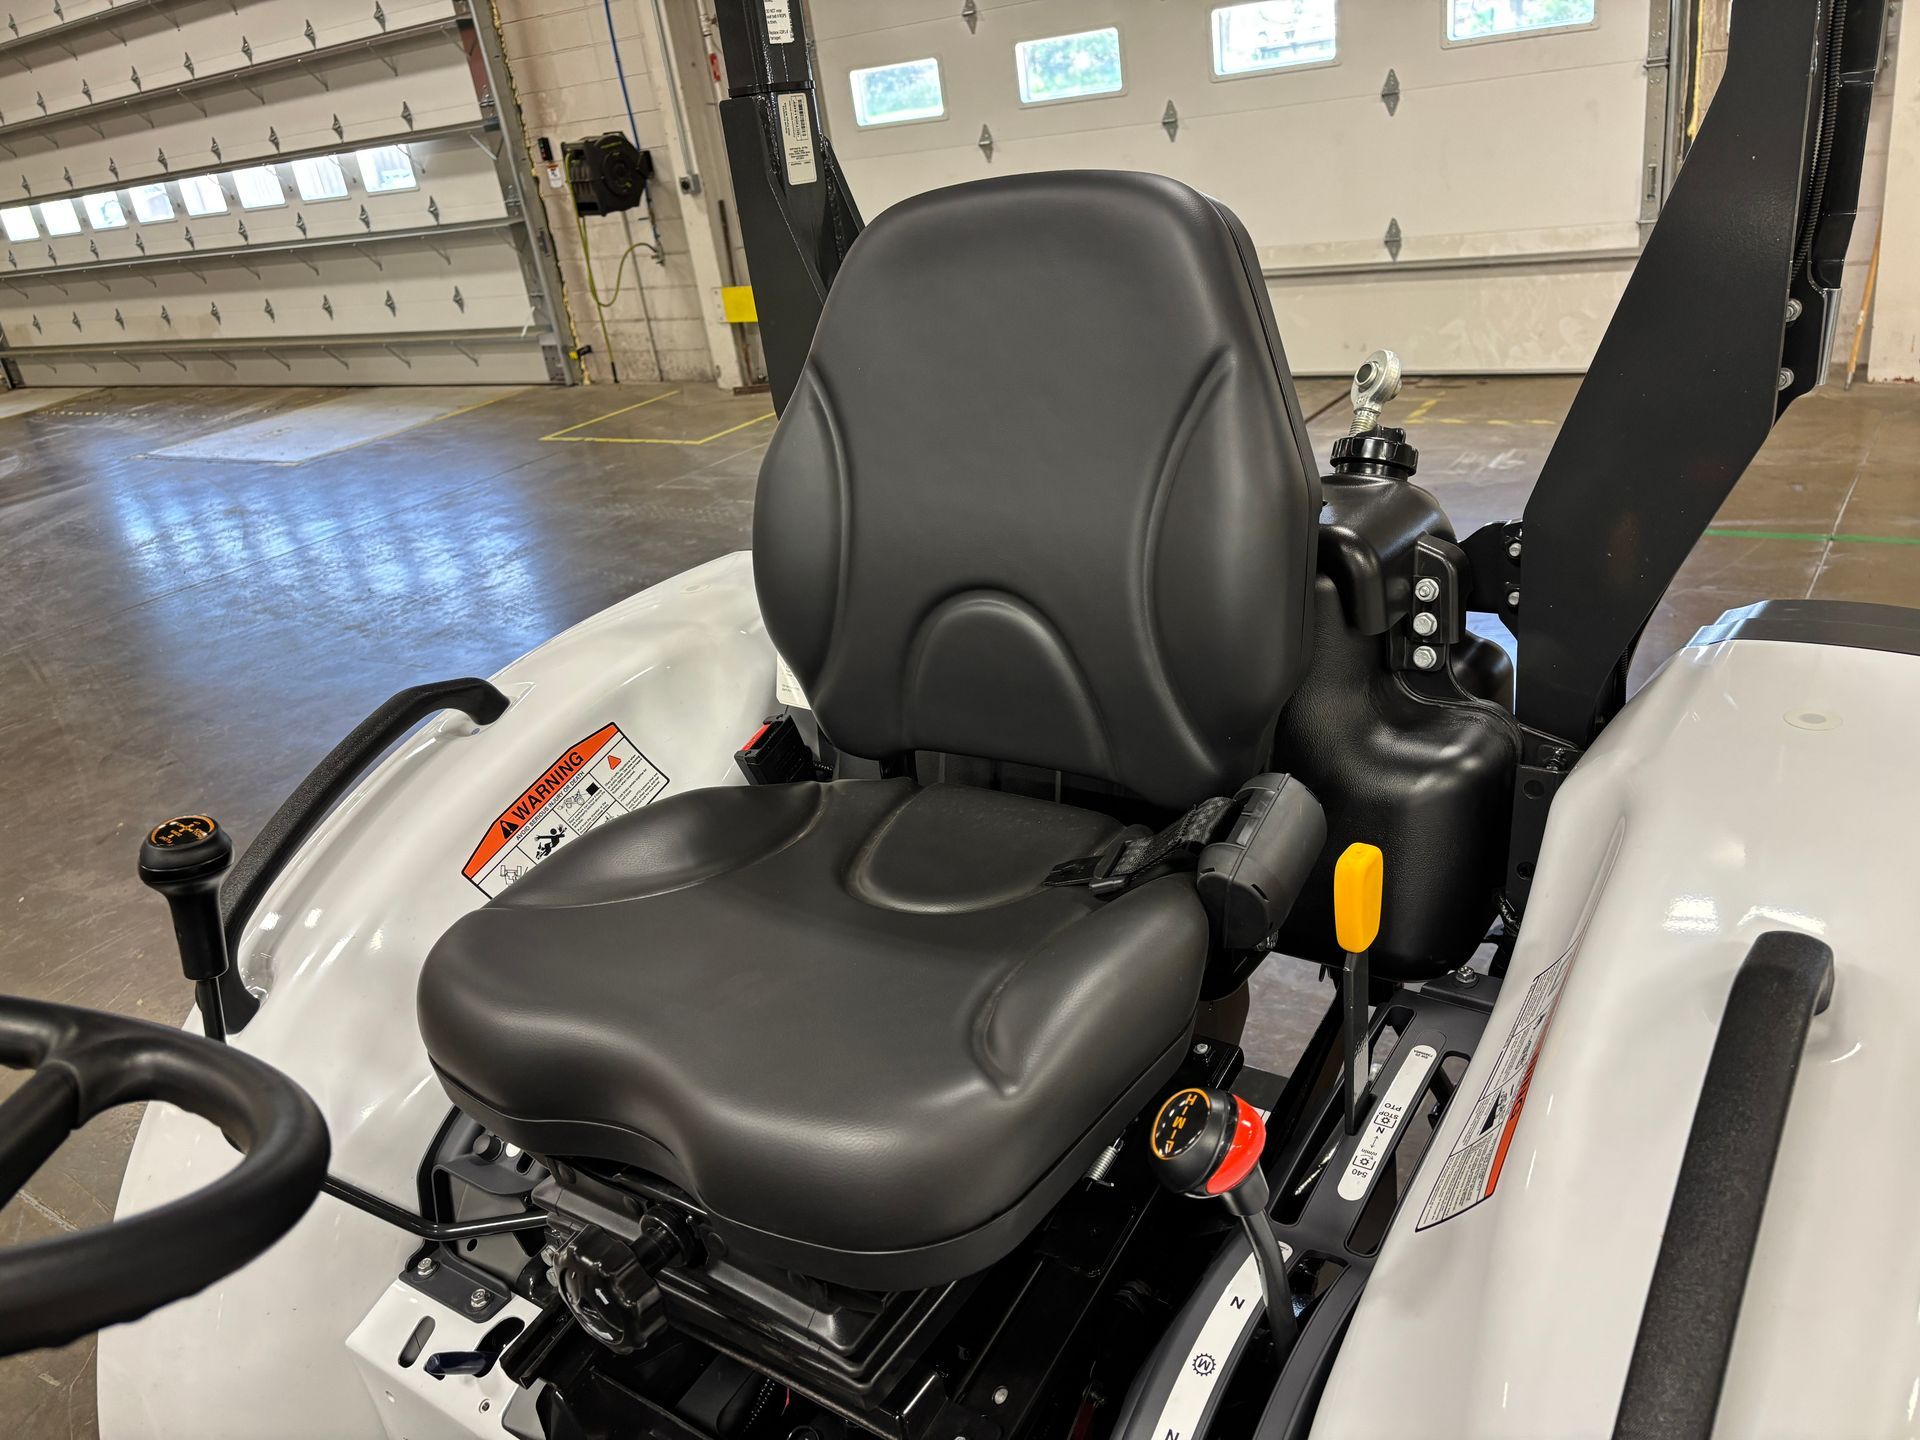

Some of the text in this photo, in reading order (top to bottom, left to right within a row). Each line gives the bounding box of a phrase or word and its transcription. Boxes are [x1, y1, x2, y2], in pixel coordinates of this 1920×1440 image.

[511, 751, 584, 821] WARNING
[516, 771, 586, 841] AVOID SERIOUS INJURY OR DEATH
[1184, 1093, 1198, 1106] H
[1384, 1102, 1402, 1112] PTO
[1379, 1111, 1399, 1120] STOP
[1376, 1126, 1386, 1134] N
[1351, 1168, 1368, 1178] 540
[1230, 1296, 1245, 1310] N
[1164, 1428, 1180, 1440] N
